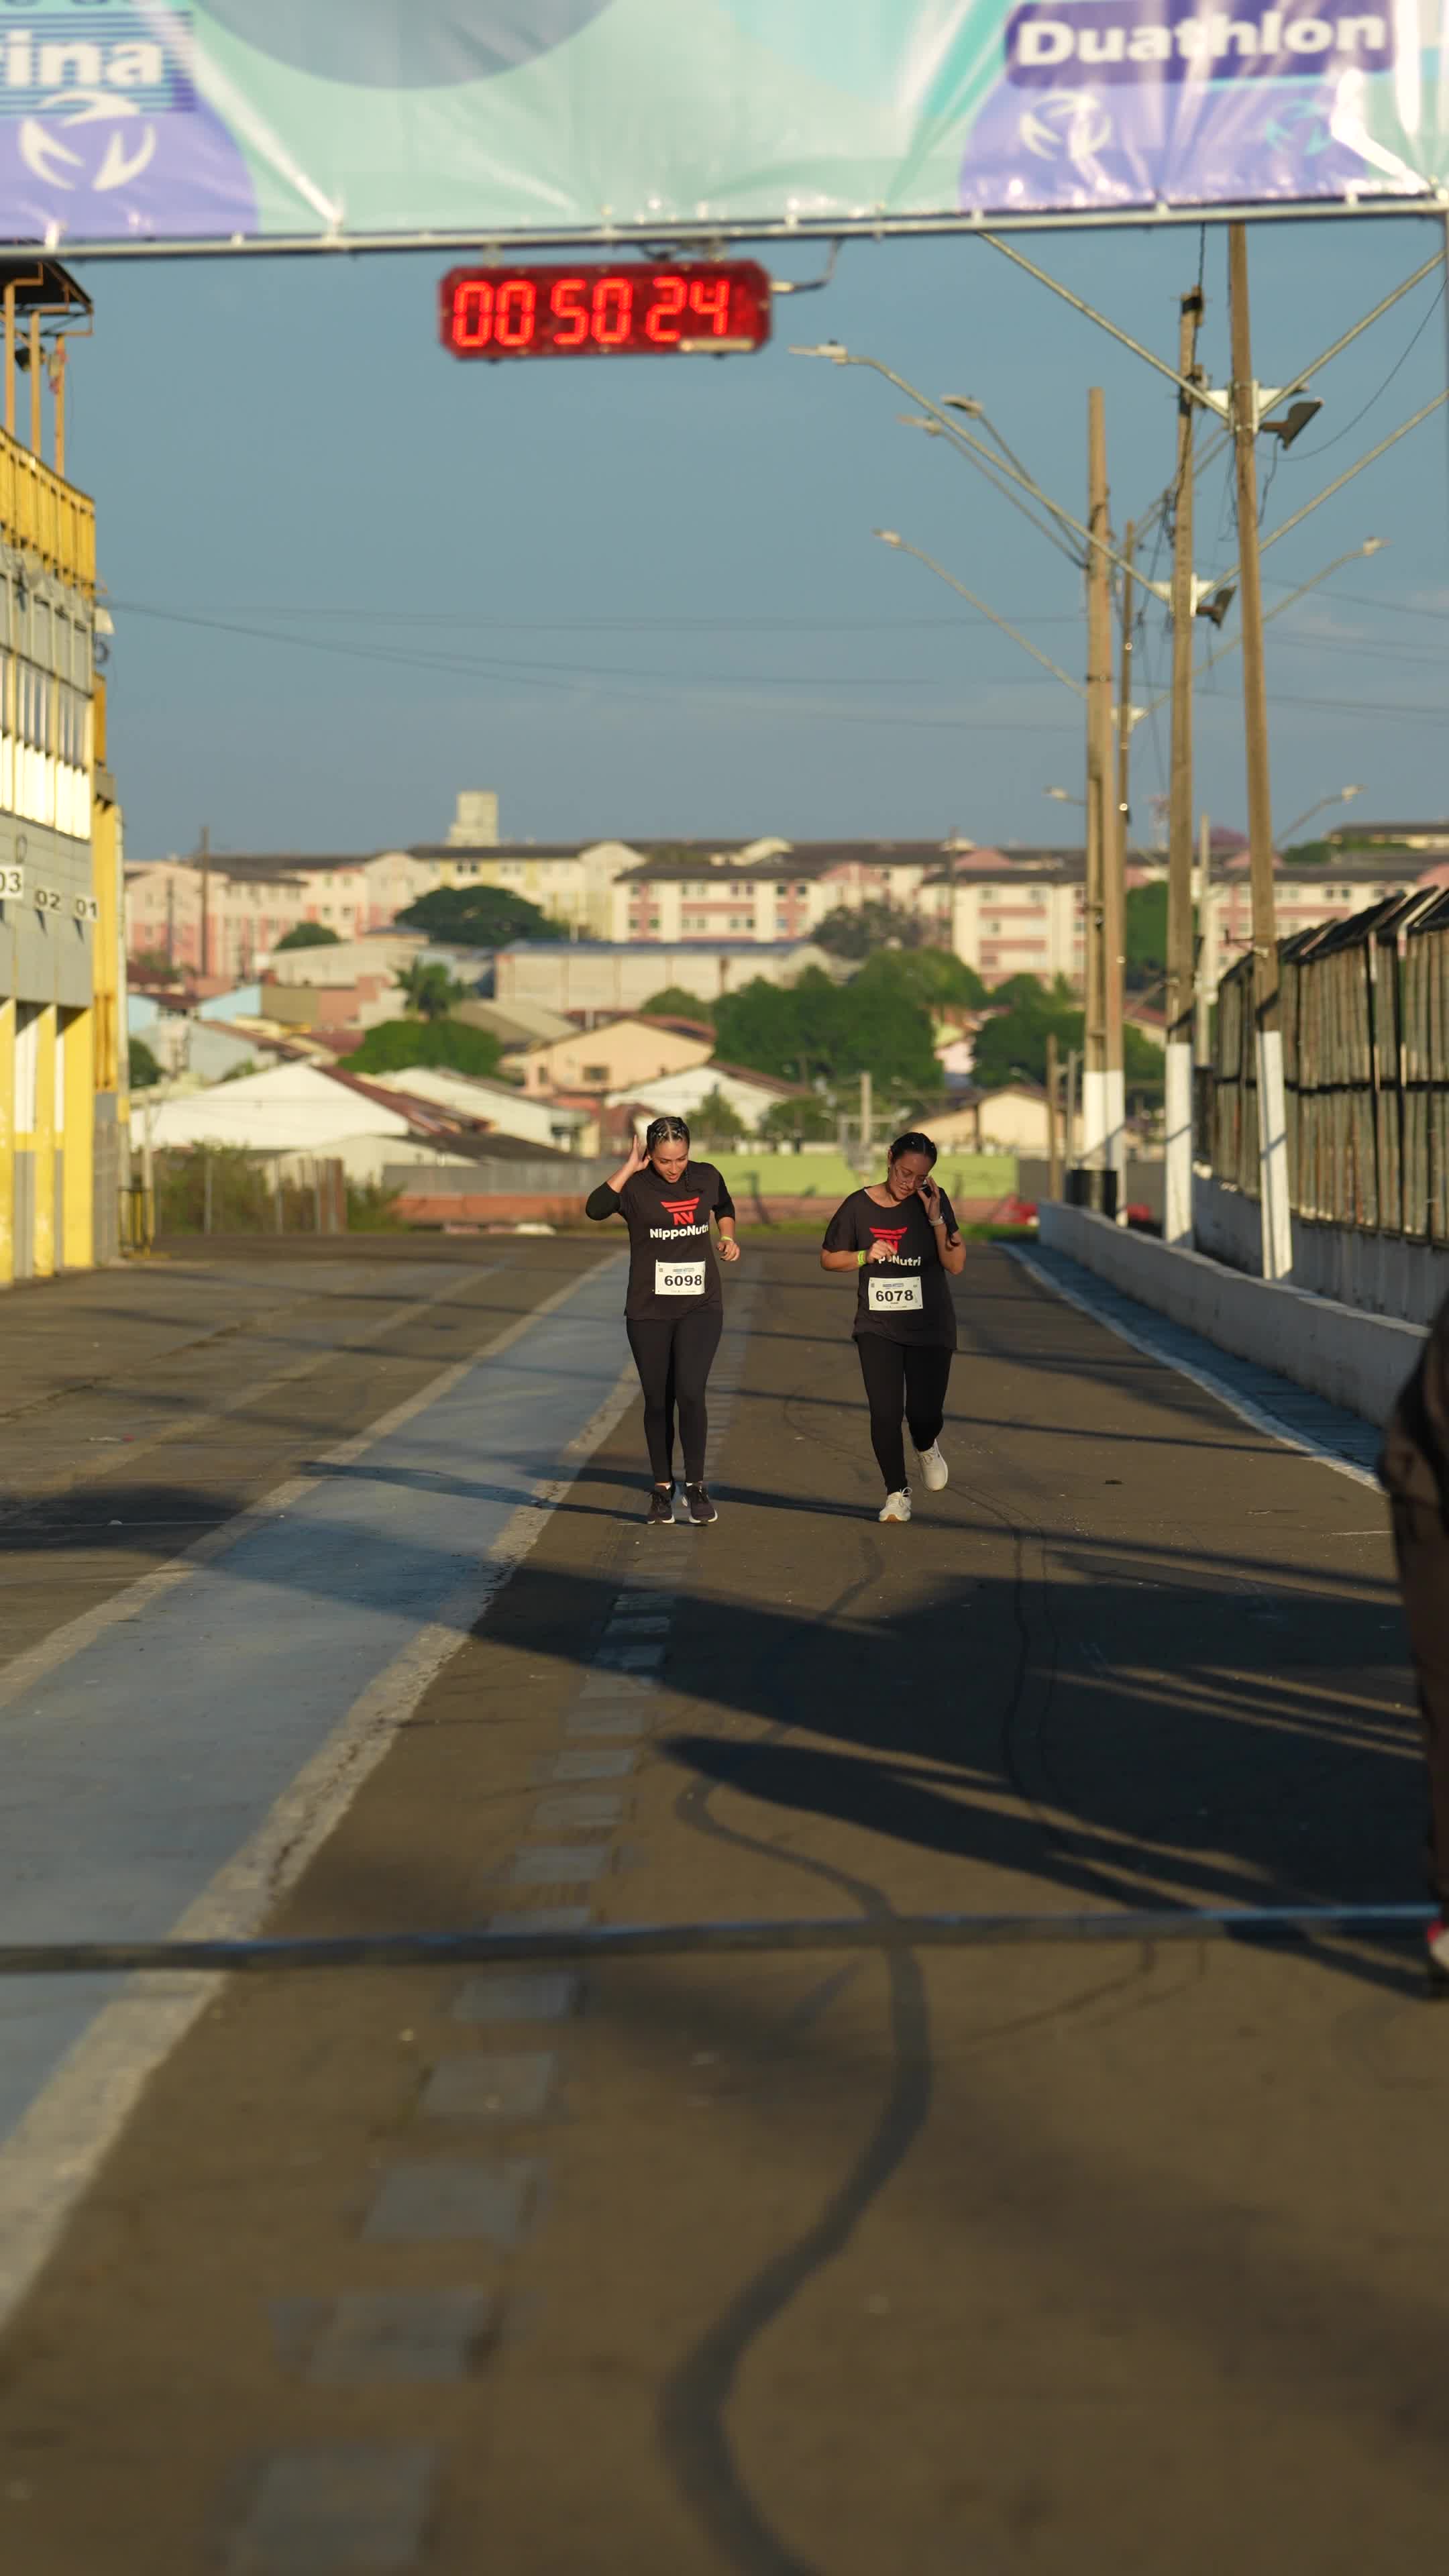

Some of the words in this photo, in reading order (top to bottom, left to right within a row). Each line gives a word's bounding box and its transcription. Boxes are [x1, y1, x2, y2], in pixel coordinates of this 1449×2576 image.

[1017, 11, 1387, 66] Duathlon
[0, 29, 163, 87] ina
[452, 280, 535, 347] 00
[550, 278, 633, 345] 50
[645, 276, 729, 343] 24
[35, 889, 61, 911] 02
[76, 899, 97, 918] 01
[664, 1275, 702, 1287] 6098
[875, 1289, 914, 1302] 6078
